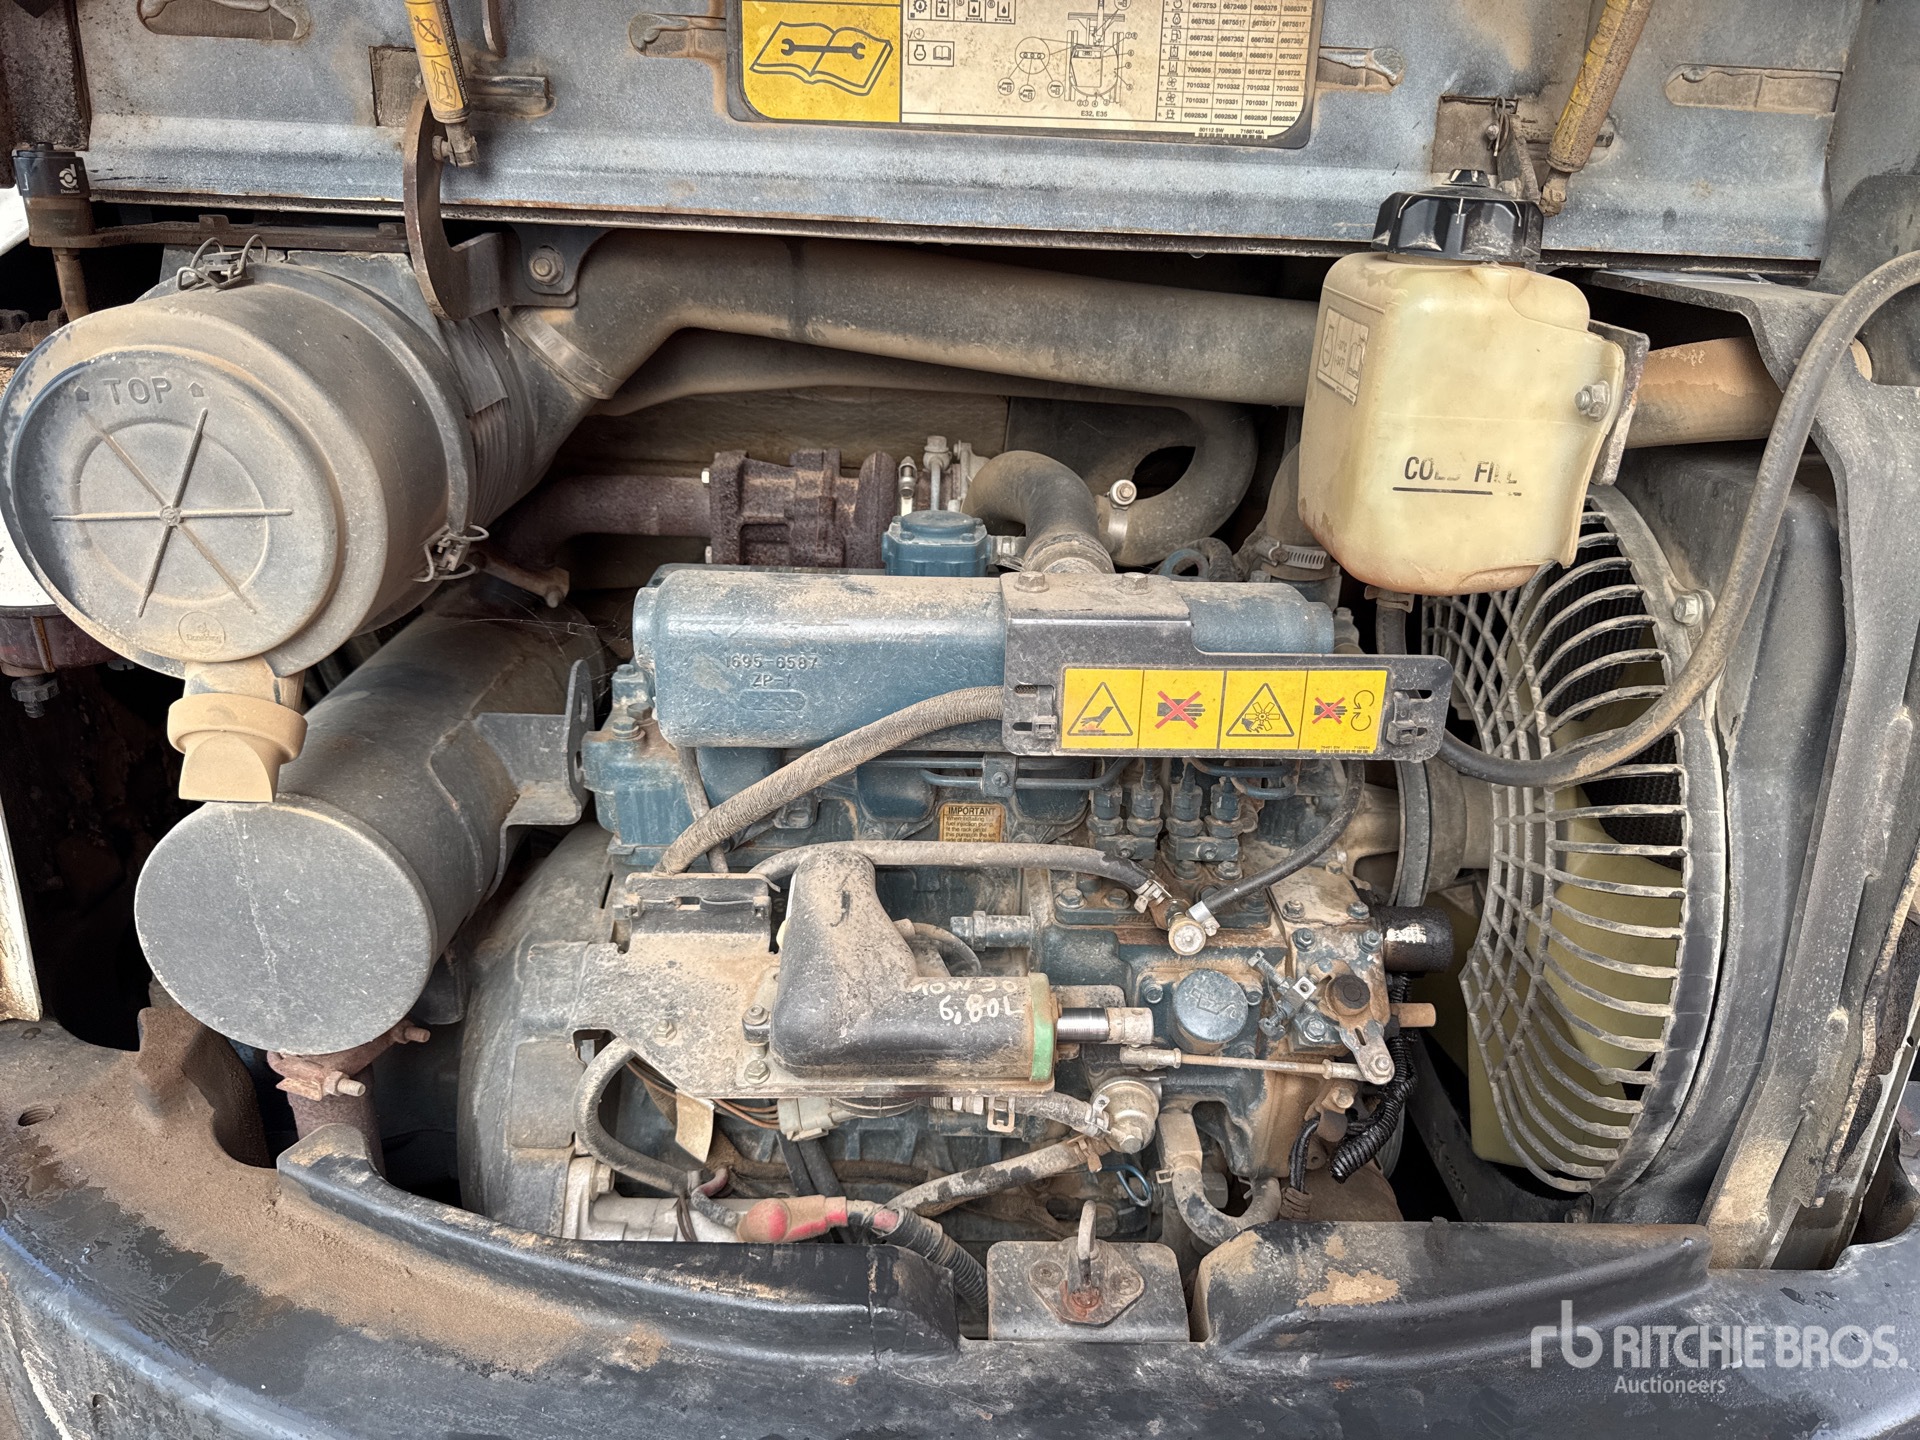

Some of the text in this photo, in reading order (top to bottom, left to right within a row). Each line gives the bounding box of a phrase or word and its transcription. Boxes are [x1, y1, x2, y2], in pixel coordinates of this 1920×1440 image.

[101, 376, 172, 405] TOP
[1404, 456, 1460, 481] CO
[948, 806, 997, 815] IMPORTANT
